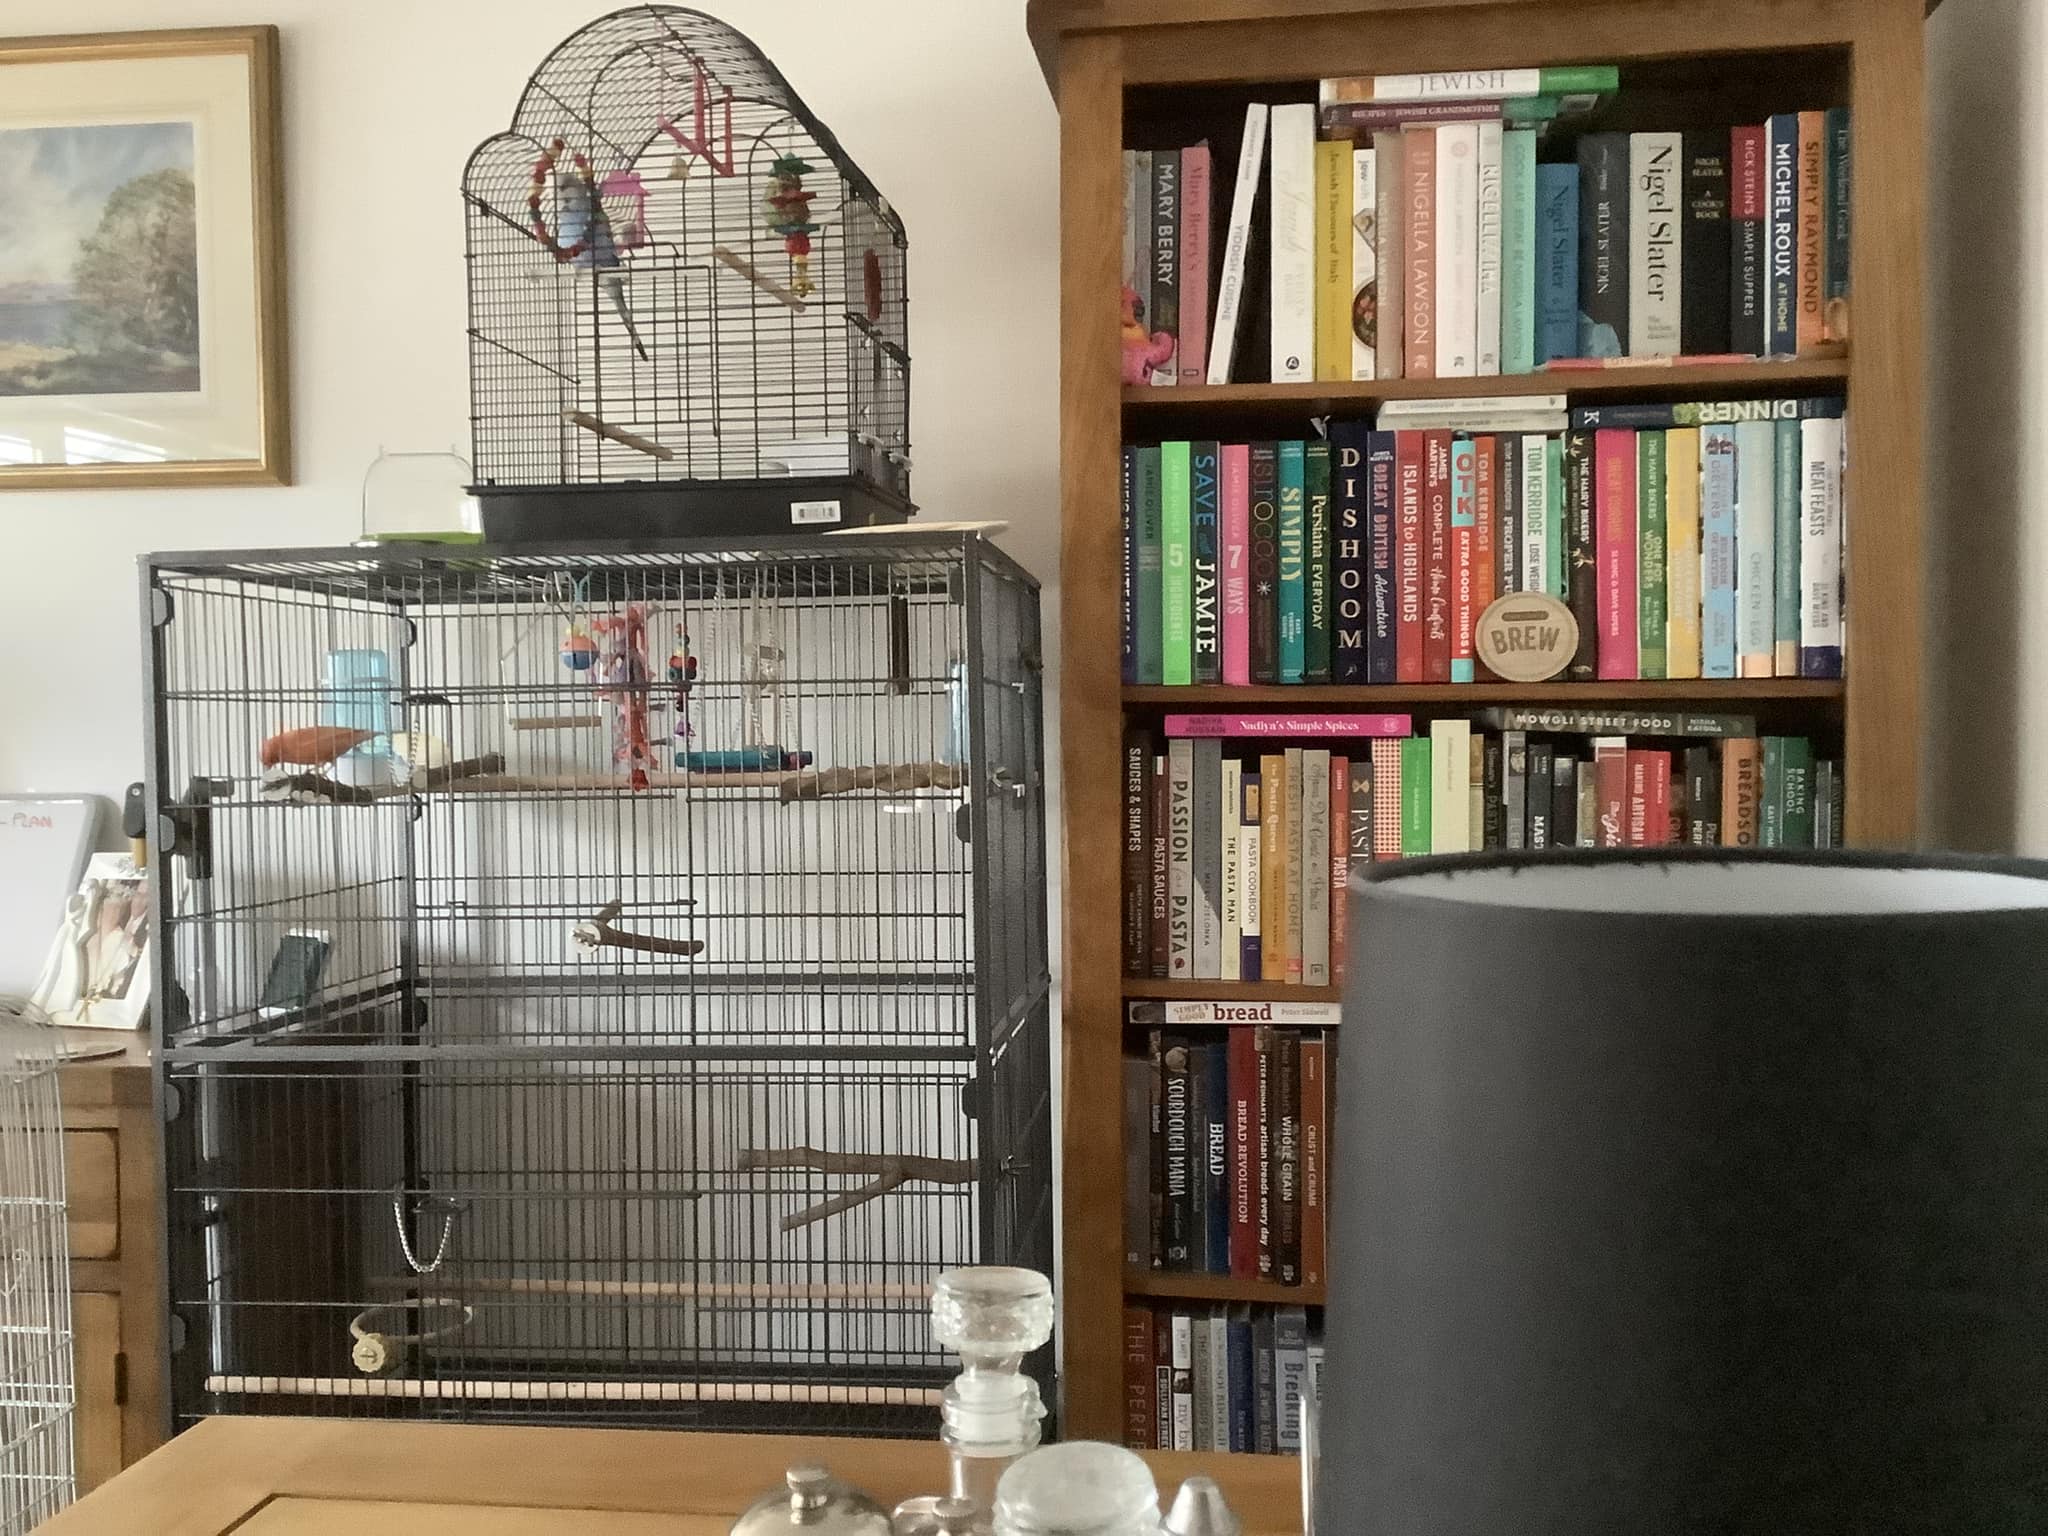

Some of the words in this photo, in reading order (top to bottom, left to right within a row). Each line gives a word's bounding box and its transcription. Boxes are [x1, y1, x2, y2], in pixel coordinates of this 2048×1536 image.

[1420, 73, 1505, 96] JEWISH
[1744, 139, 1754, 170] RICK
[1805, 141, 1819, 209] SIMPLY
[1158, 164, 1174, 219] MARY
[1639, 144, 1674, 213] Nigel
[1744, 171, 1754, 215] STEIN'S
[1775, 143, 1791, 219] MICHEL
[1413, 172, 1428, 251] NIGELLA
[1545, 185, 1569, 233] Nigel
[1598, 201, 1610, 250] SLATER
[1158, 225, 1173, 285] BERRY
[1228, 224, 1244, 272] YIDDISH
[1647, 222, 1674, 302] Slater
[1744, 221, 1755, 263] SIMPLE
[1775, 223, 1791, 277] ROUX
[1551, 237, 1568, 290] Slater
[1597, 255, 1609, 293] NIGEL
[1804, 214, 1818, 313] RAYMOND
[1222, 275, 1237, 321] CUISINE
[1413, 259, 1428, 344] LAWSON
[1743, 265, 1754, 317] SUPPERS
[1777, 282, 1789, 295] AT
[1776, 297, 1789, 332] HOME
[1698, 400, 1798, 422] DINNER
[1429, 440, 1438, 487] MARTIN'S
[1439, 447, 1447, 480] JAMES
[1478, 453, 1488, 481] TOM
[1528, 446, 1542, 471] TOM
[1580, 457, 1589, 475] THE
[1648, 440, 1656, 456] THE
[1195, 455, 1215, 527] SAVE
[1232, 463, 1240, 493] JAMIE
[1374, 464, 1388, 507] GREAT
[1457, 454, 1473, 515] OTK
[1580, 478, 1589, 506] HAIRY
[1648, 459, 1657, 485] HAIRY
[1810, 461, 1824, 491] MEAT
[1403, 465, 1417, 524] ISLANDS
[1528, 476, 1542, 536] KERRIDGE
[1145, 499, 1153, 540] OLIVER
[1232, 498, 1241, 538] OLIVER
[1253, 463, 1274, 577] sirocco
[1281, 487, 1301, 582] SIMPLY
[1311, 495, 1327, 558] Persiana
[1404, 527, 1416, 540] to
[1432, 495, 1442, 560] COMPLETE
[1478, 487, 1488, 552] KERRIDGE
[1580, 509, 1590, 544] BIKERS'
[1809, 494, 1825, 537] FEASTS
[1169, 543, 1183, 568] 5
[1228, 545, 1243, 569] 7
[1338, 447, 1362, 649] DISHOOM
[1374, 514, 1388, 569] BRITISH
[1460, 531, 1469, 566] EXTRA
[1504, 516, 1513, 572] PROPER
[1529, 543, 1539, 564] LOSE
[1643, 530, 1653, 589] WONDERS
[1653, 536, 1662, 559] ONE
[1403, 543, 1417, 622] HIGHLANDS
[1460, 569, 1469, 601] GOOD
[1529, 566, 1540, 592] WEIGH
[1654, 563, 1662, 583] POT
[1750, 552, 1761, 610] CHICKEN
[1195, 558, 1215, 654] JAMIE
[1227, 577, 1243, 614] WAYS
[1312, 564, 1323, 630] EVERYDAY
[1374, 574, 1388, 638] Adventure
[1460, 605, 1469, 646] THINGS
[1491, 626, 1560, 654] BREW
[1750, 620, 1761, 646] EGG
[1239, 720, 1284, 733] Nadiya's
[1286, 720, 1323, 732] Simple
[1325, 720, 1359, 732] Spices
[1516, 714, 1573, 726] MOWGLI
[1580, 716, 1626, 727] STREET
[1633, 718, 1672, 728] FOOD
[1128, 747, 1142, 793] SAUCES
[1288, 767, 1298, 811] FRESH
[1634, 764, 1644, 794] MAKING
[1128, 796, 1141, 804] &
[1269, 778, 1279, 812] Pasta
[1738, 759, 1752, 845] BREADSO
[1786, 768, 1795, 814] SCHOOL
[1796, 768, 1805, 814] BAKING
[1128, 807, 1142, 852] SHAPES
[1173, 780, 1188, 862] PASSION
[1267, 815, 1279, 852] Queen
[1351, 809, 1369, 864] PAST
[1632, 797, 1644, 840] ARTISAN
[1154, 838, 1165, 872] PASTA
[1227, 836, 1236, 856] THE
[1248, 838, 1257, 868] PASTA
[1288, 820, 1298, 863] PASTA
[1227, 861, 1235, 894] PASTA
[1288, 869, 1298, 887] AT
[1333, 857, 1346, 888] PASTA
[1154, 874, 1165, 919] SAUCES
[1227, 899, 1235, 922] MAN
[1248, 871, 1257, 924] COOKBOOK
[1288, 893, 1298, 936] HOME
[1172, 895, 1188, 953] PASTA
[1213, 1003, 1272, 1021] bread
[1259, 1055, 1267, 1078] PETER
[1281, 1040, 1291, 1064] Peter
[1168, 1078, 1186, 1151] SOURDOUGH
[1237, 1100, 1247, 1141] BREAD
[1209, 1122, 1224, 1176] BREAD
[1259, 1125, 1269, 1158] artisan
[1281, 1116, 1292, 1159] WHOLE
[1308, 1125, 1316, 1154] CRUST
[1168, 1156, 1186, 1196] MANIA
[1237, 1144, 1247, 1223] REVOLUTION
[1259, 1161, 1269, 1195] breads
[1281, 1162, 1292, 1201] GRAIN
[1308, 1156, 1316, 1170] and
[1308, 1173, 1316, 1207] CRUMB
[1256, 1198, 1268, 1224] every
[1257, 1227, 1269, 1246] day
[1128, 1322, 1145, 1363] THE
[1128, 1385, 1146, 1450] PERFE
[1160, 1378, 1168, 1418] SULLIVAN
[1176, 1403, 1188, 1425] my
[1281, 1362, 1304, 1440] Breaking
